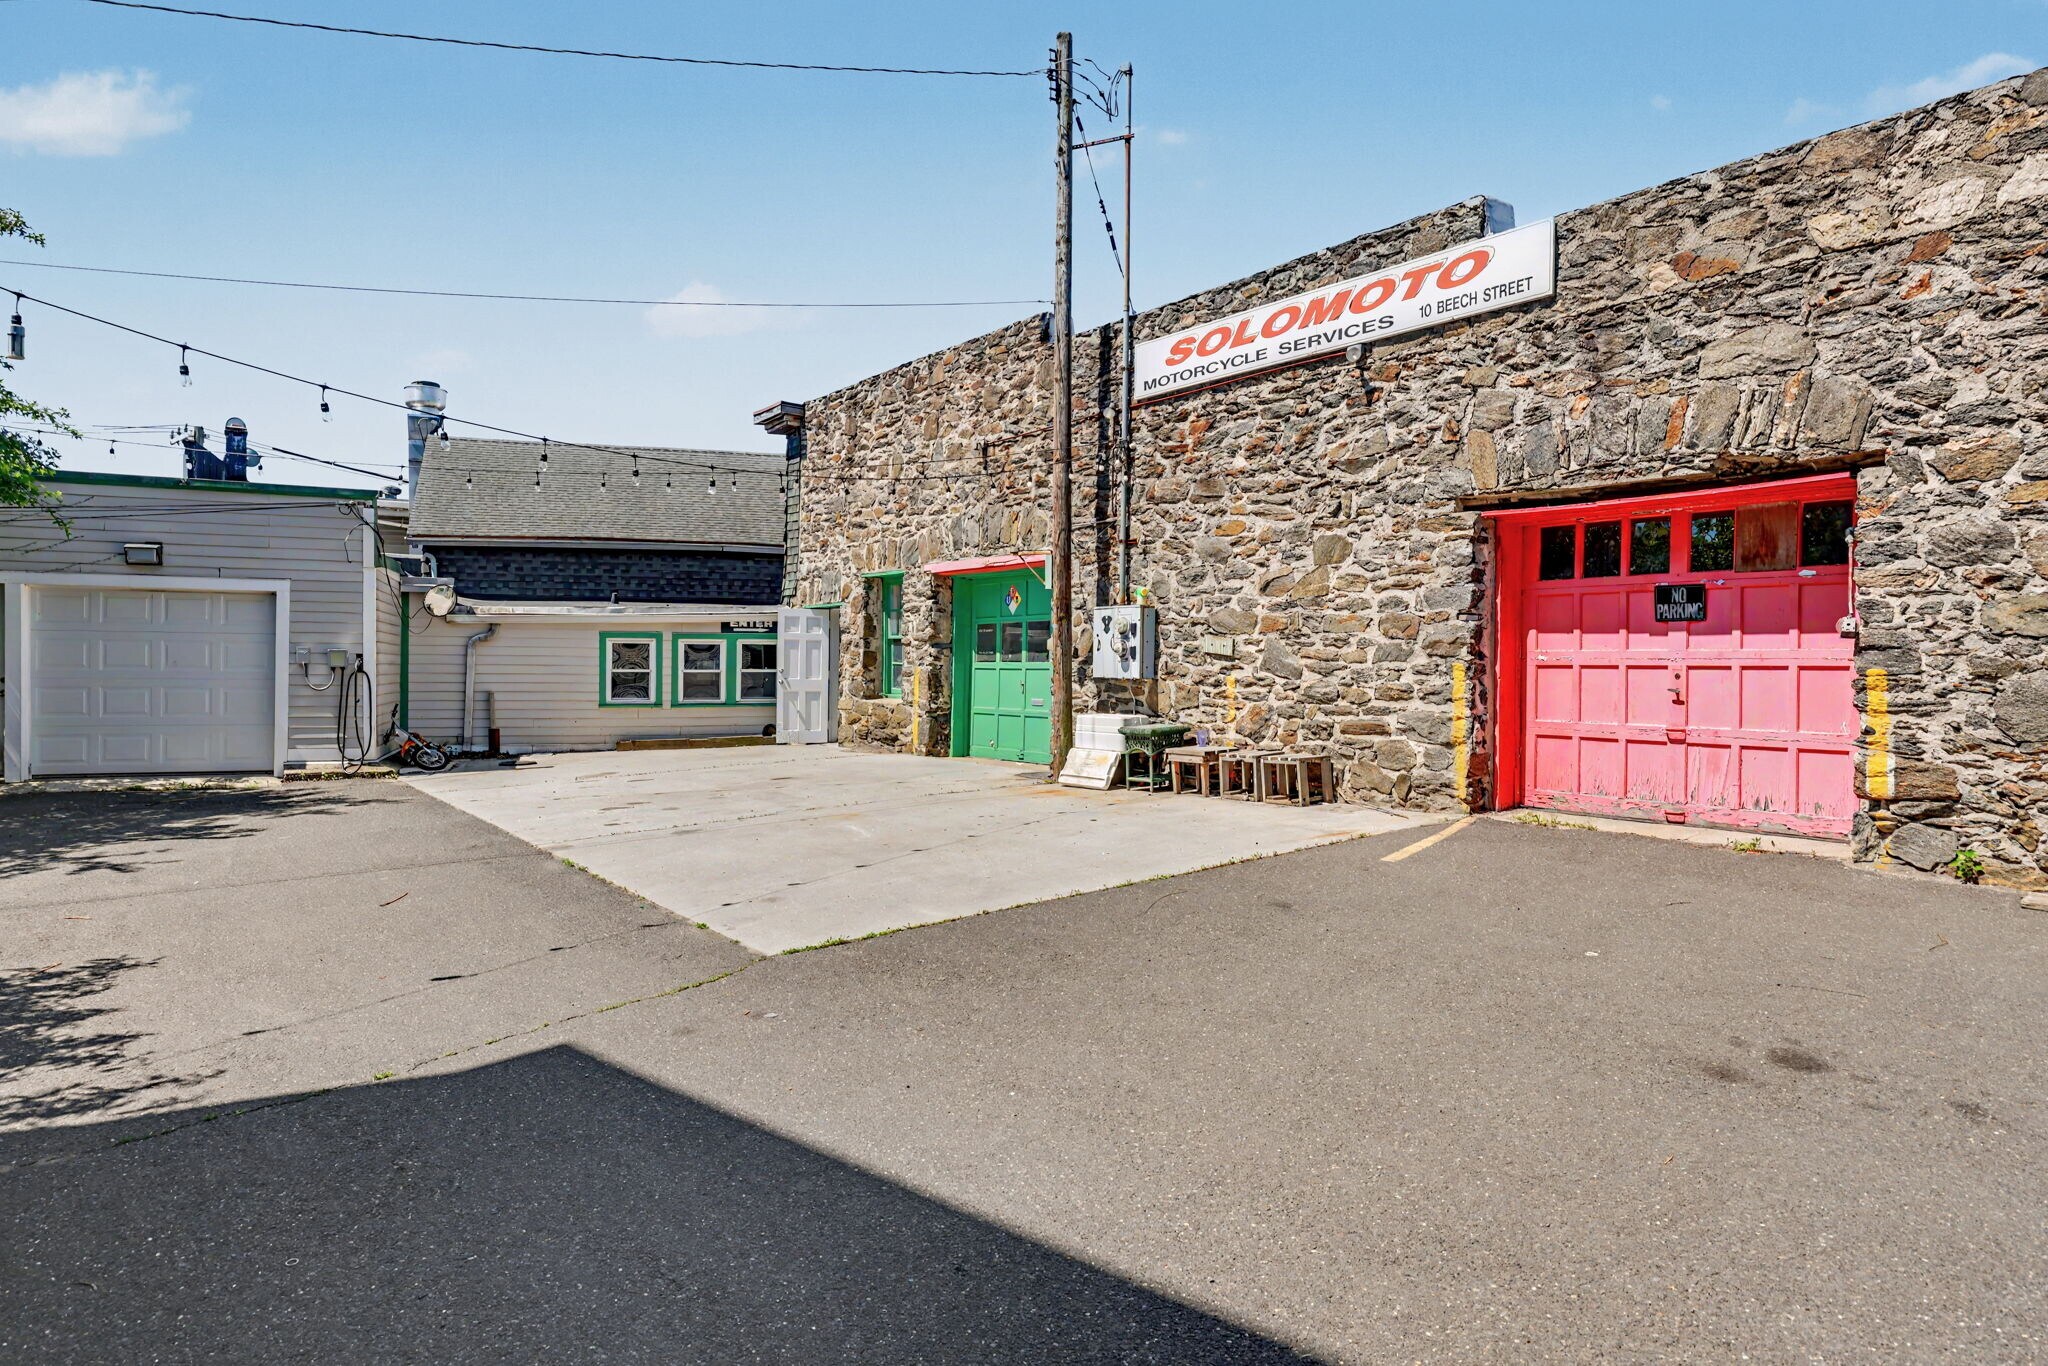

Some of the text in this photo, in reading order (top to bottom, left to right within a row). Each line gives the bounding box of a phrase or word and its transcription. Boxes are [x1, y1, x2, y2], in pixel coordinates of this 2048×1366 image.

[1165, 246, 1494, 367] SOLOMOTO
[1418, 276, 1534, 319] 10 BEECH STREET
[1143, 315, 1395, 391] MOTORCYCLE SERVICES
[1657, 602, 1704, 619] PARKING
[1671, 587, 1687, 602] NO
